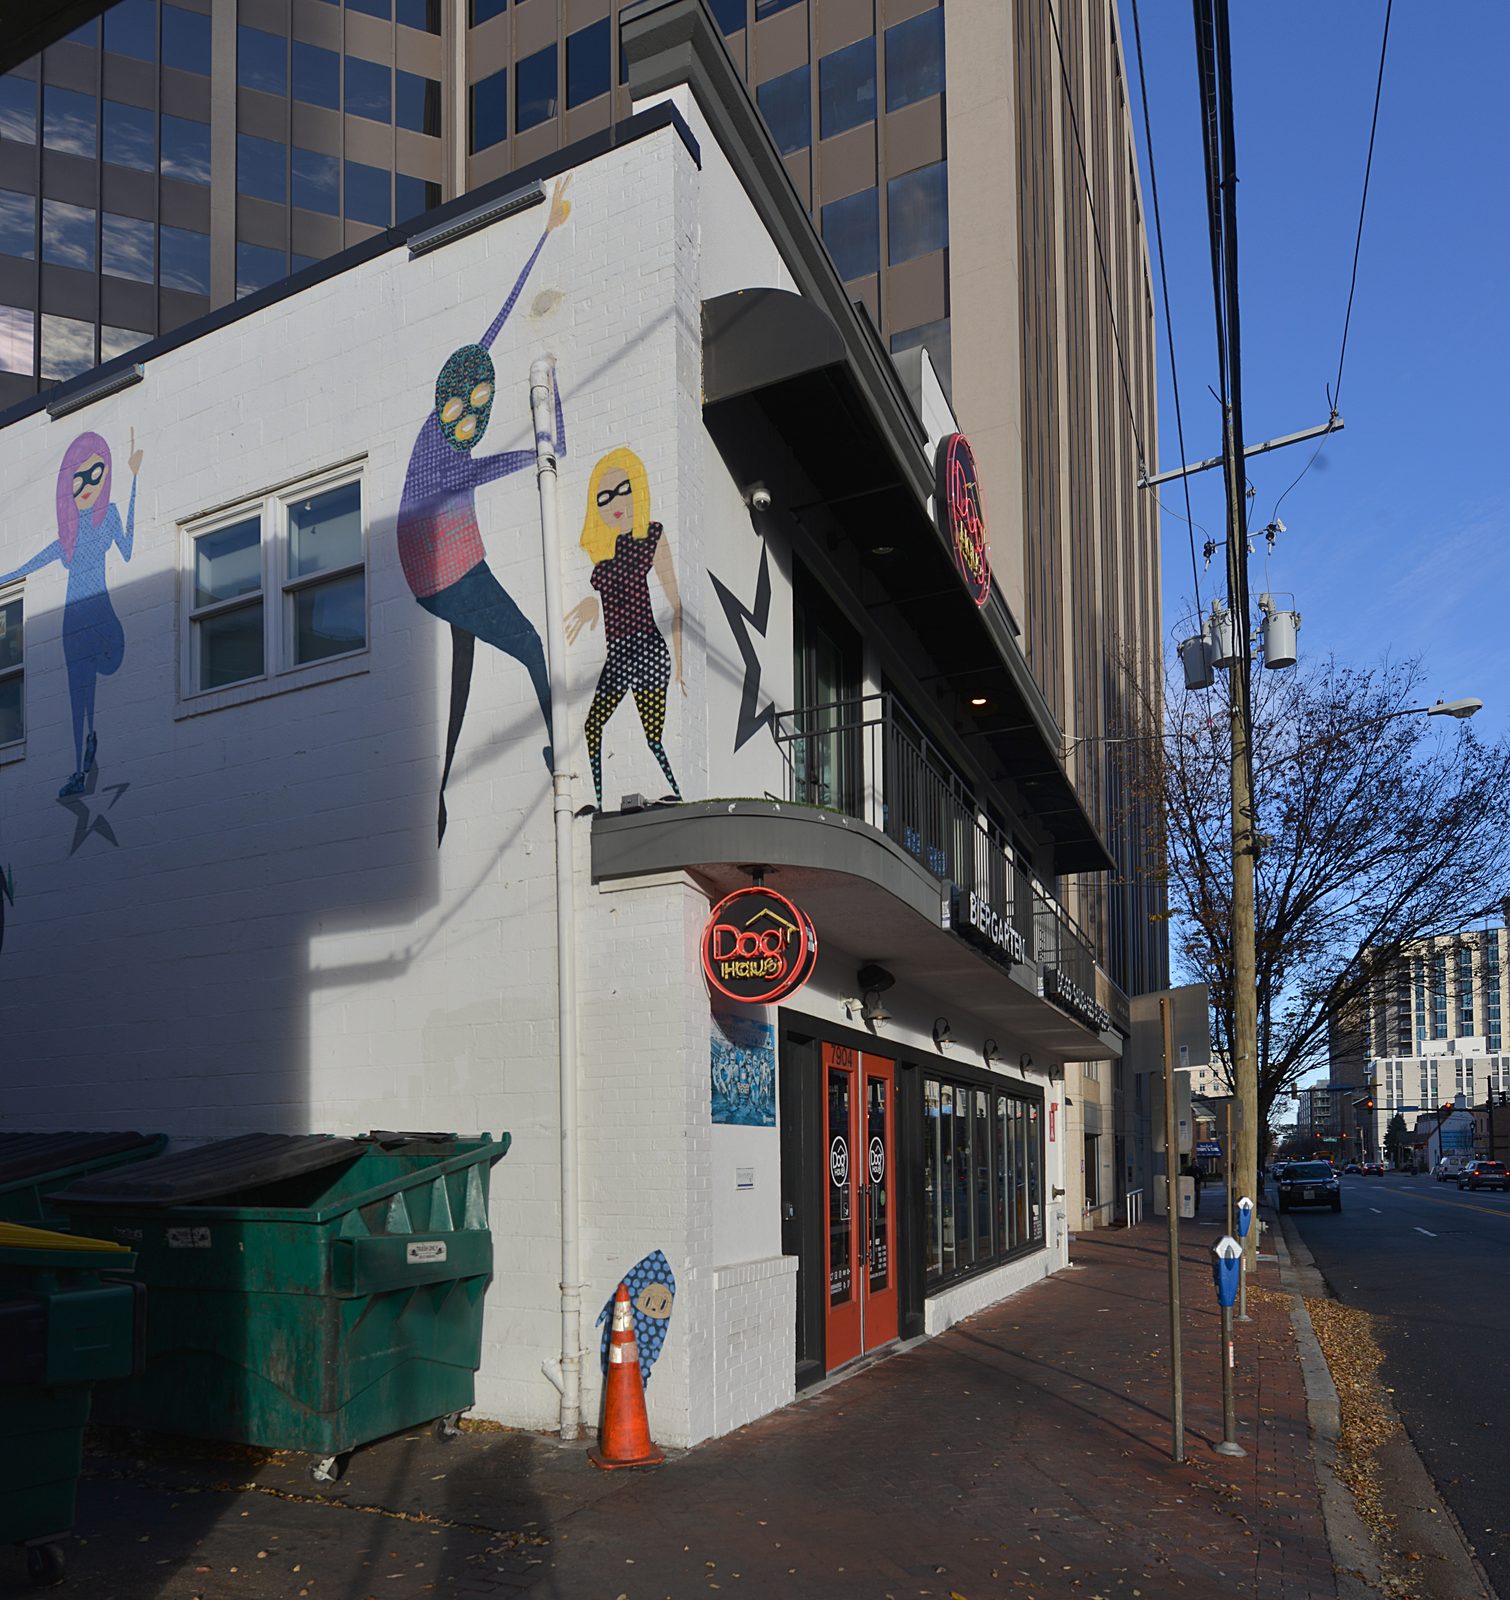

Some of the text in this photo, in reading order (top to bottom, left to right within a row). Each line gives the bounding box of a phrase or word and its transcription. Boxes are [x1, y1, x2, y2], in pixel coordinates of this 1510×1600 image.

[713, 924, 788, 980] Dog
[969, 890, 1026, 965] BIERGARTEN
[831, 1043, 853, 1068] 7904
